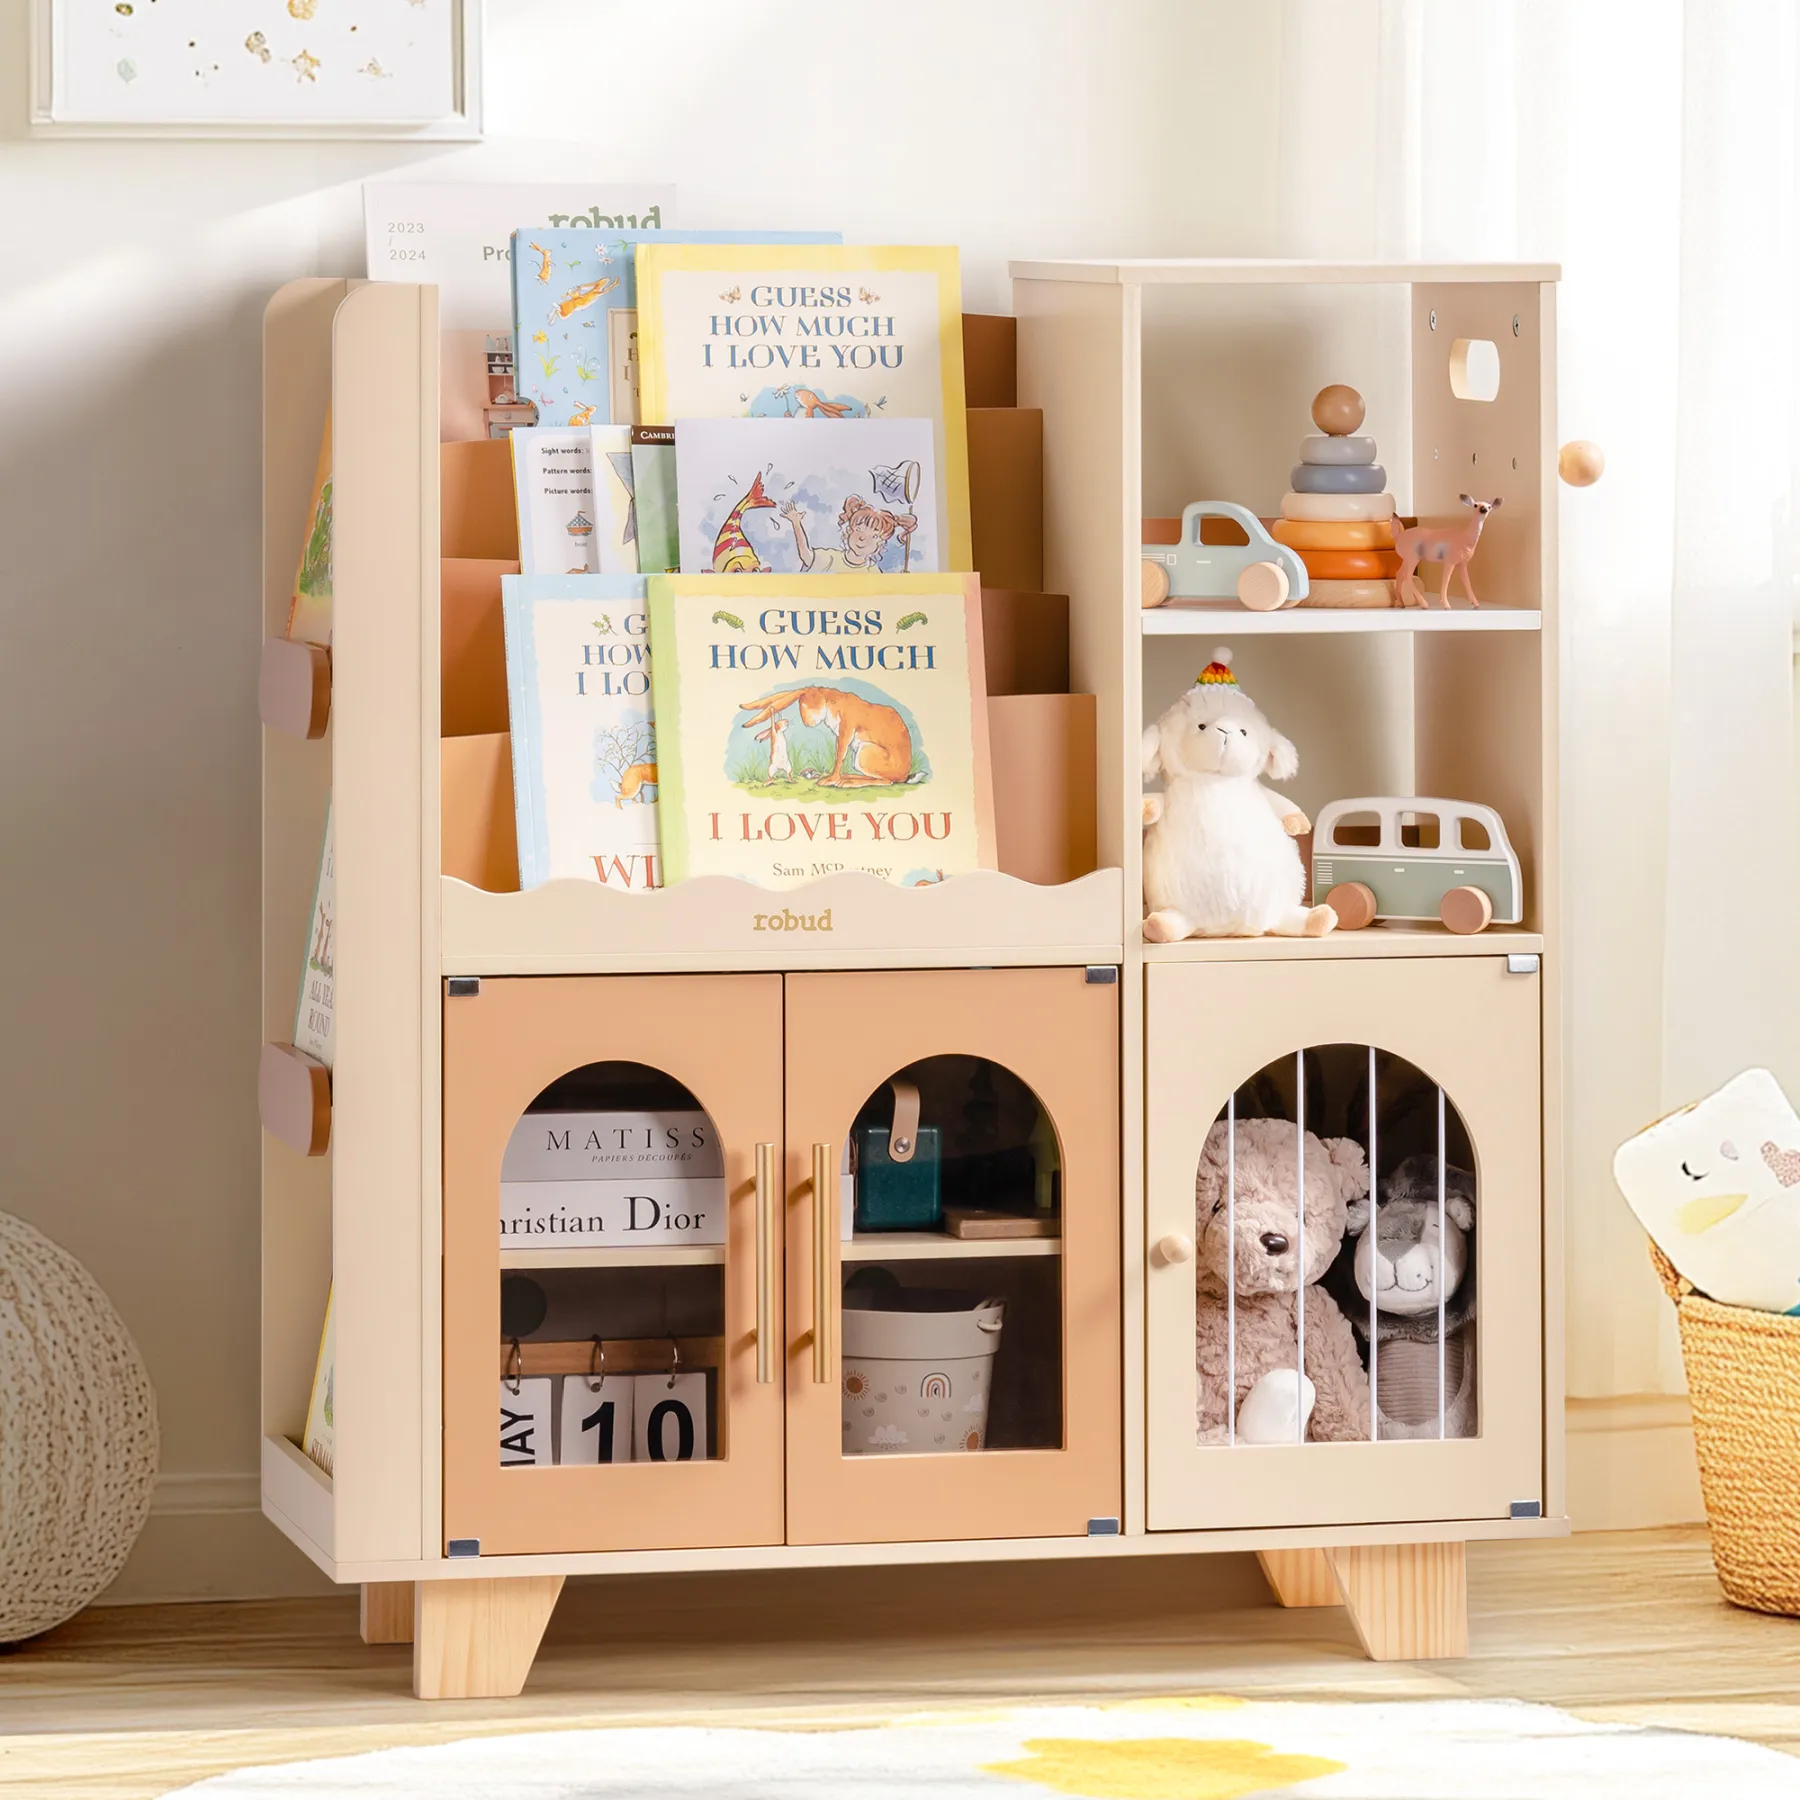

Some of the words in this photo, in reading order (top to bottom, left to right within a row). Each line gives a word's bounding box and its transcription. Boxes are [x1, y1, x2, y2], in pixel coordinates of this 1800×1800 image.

[388, 222, 425, 233] 2023
[389, 249, 426, 261] 2024
[750, 285, 852, 308] GUESS
[709, 315, 787, 337] HOW
[796, 315, 896, 338] MUCH
[702, 344, 714, 368] I
[727, 344, 821, 369] LOVE
[828, 344, 905, 369] YOU
[640, 430, 675, 440] CAMBRI
[541, 447, 559, 456] Sight
[544, 487, 569, 495] Picture
[624, 613, 650, 635] G
[759, 609, 882, 635] GUESS
[708, 644, 804, 670] HOW
[816, 644, 938, 671] MUCH
[575, 671, 588, 696] I
[601, 670, 652, 696] LO
[708, 812, 723, 842] I
[739, 812, 852, 842] LOVE
[860, 812, 953, 841] YOU
[589, 854, 664, 890] WI
[772, 863, 805, 876] Sam
[753, 907, 834, 931] robud
[546, 1127, 706, 1151] MATISS
[592, 1153, 634, 1163] PAPIERS
[622, 1196, 706, 1232] Dior
[500, 1408, 536, 1466] AY
